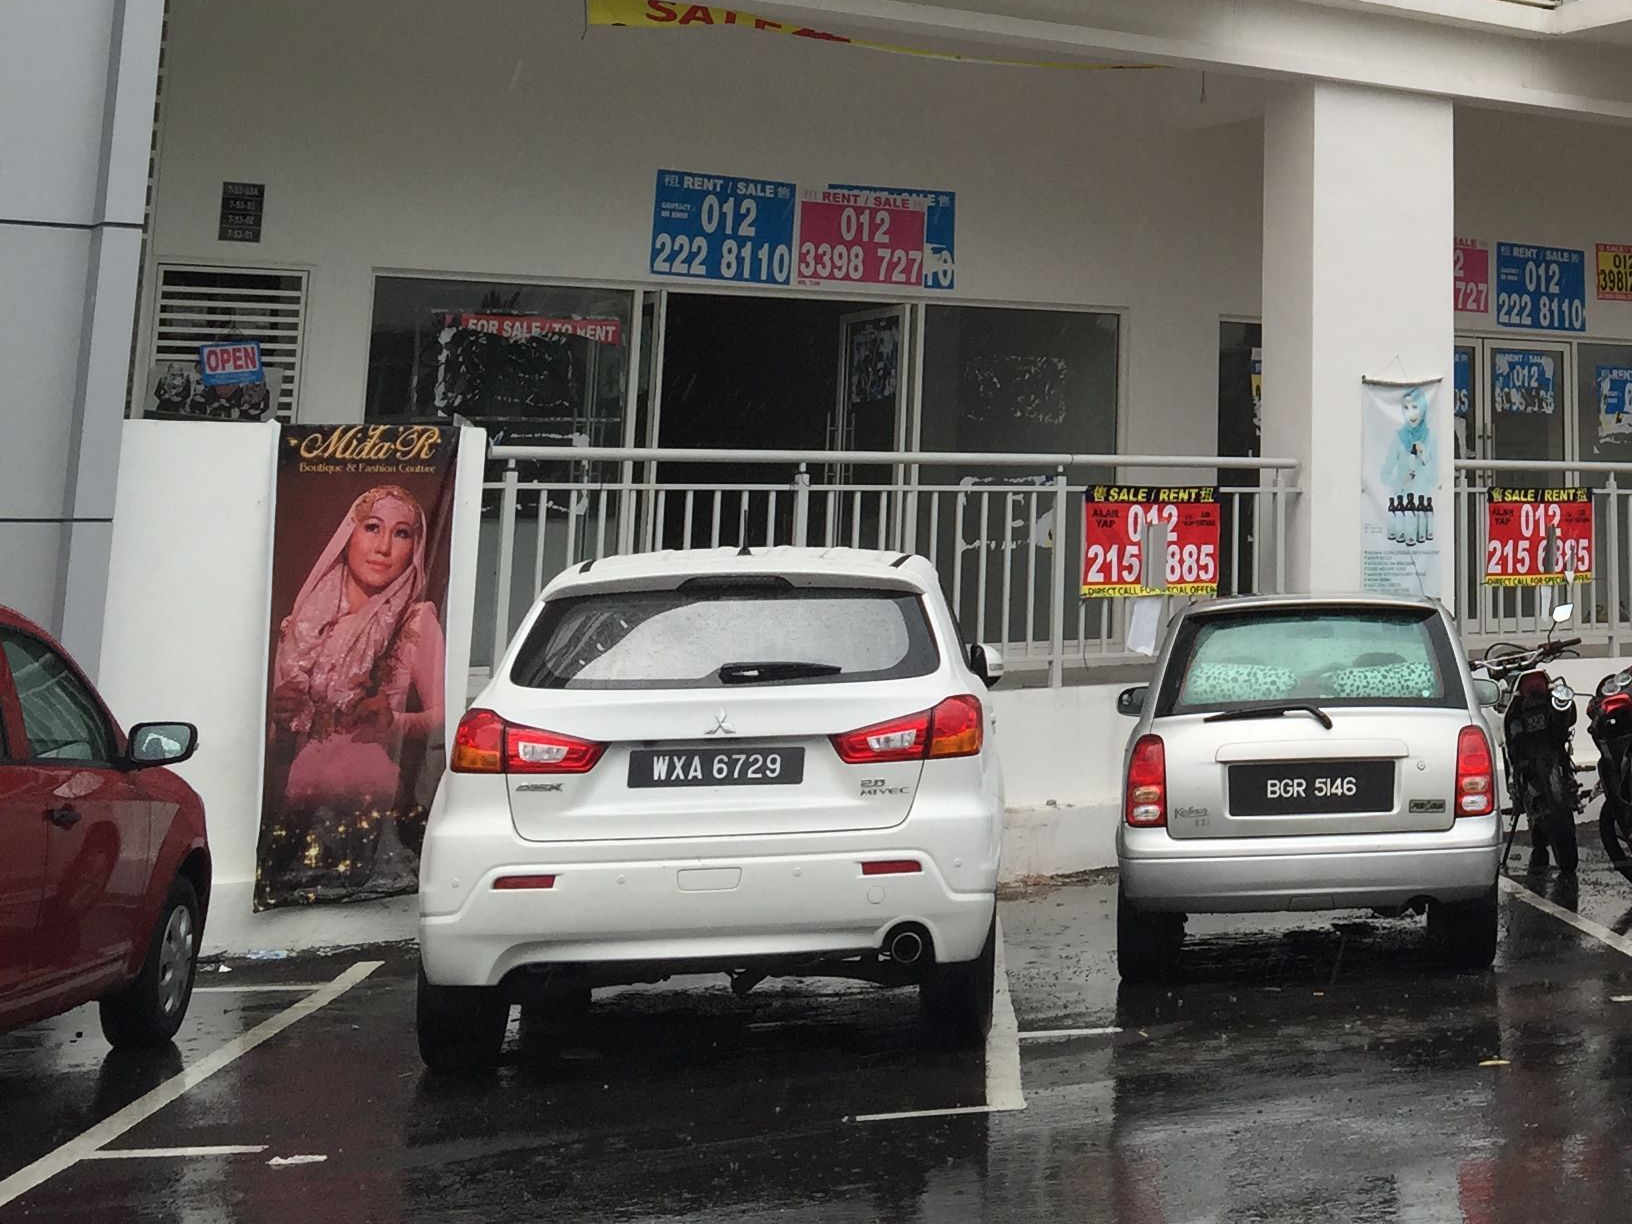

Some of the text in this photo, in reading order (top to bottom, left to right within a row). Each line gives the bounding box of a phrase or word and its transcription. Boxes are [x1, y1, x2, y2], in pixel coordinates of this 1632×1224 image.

[683, 175, 724, 192] RENT
[736, 181, 775, 197] SALE
[822, 191, 860, 205] RENT
[873, 195, 911, 209] SALE
[701, 194, 757, 237] 012
[840, 207, 890, 244] 012
[653, 233, 790, 282] 222 8110
[800, 242, 923, 283] 3398 727
[1513, 246, 1538, 259] RENT
[1545, 250, 1570, 263] SALE
[1525, 260, 1560, 294] 012
[1455, 280, 1488, 311] 727
[1498, 292, 1582, 330] 222 8110
[468, 319, 498, 335] FOR
[205, 345, 257, 373] OPEN
[1513, 365, 1538, 387] 012
[300, 462, 343, 474] Boutique
[358, 463, 397, 473] Fashion
[1108, 487, 1147, 502] SALE
[1159, 487, 1199, 502] RENT
[1504, 488, 1535, 502] SALE
[1544, 488, 1575, 502] RENT
[1520, 503, 1561, 537] 012
[1087, 544, 1215, 583] 215 885
[1487, 539, 1531, 574] 215
[1118, 586, 1138, 596] CALL
[1512, 577, 1530, 585] CALL
[653, 754, 782, 781] WXA 6729
[515, 782, 564, 793] ASX
[1267, 777, 1357, 799] BGR 5146
